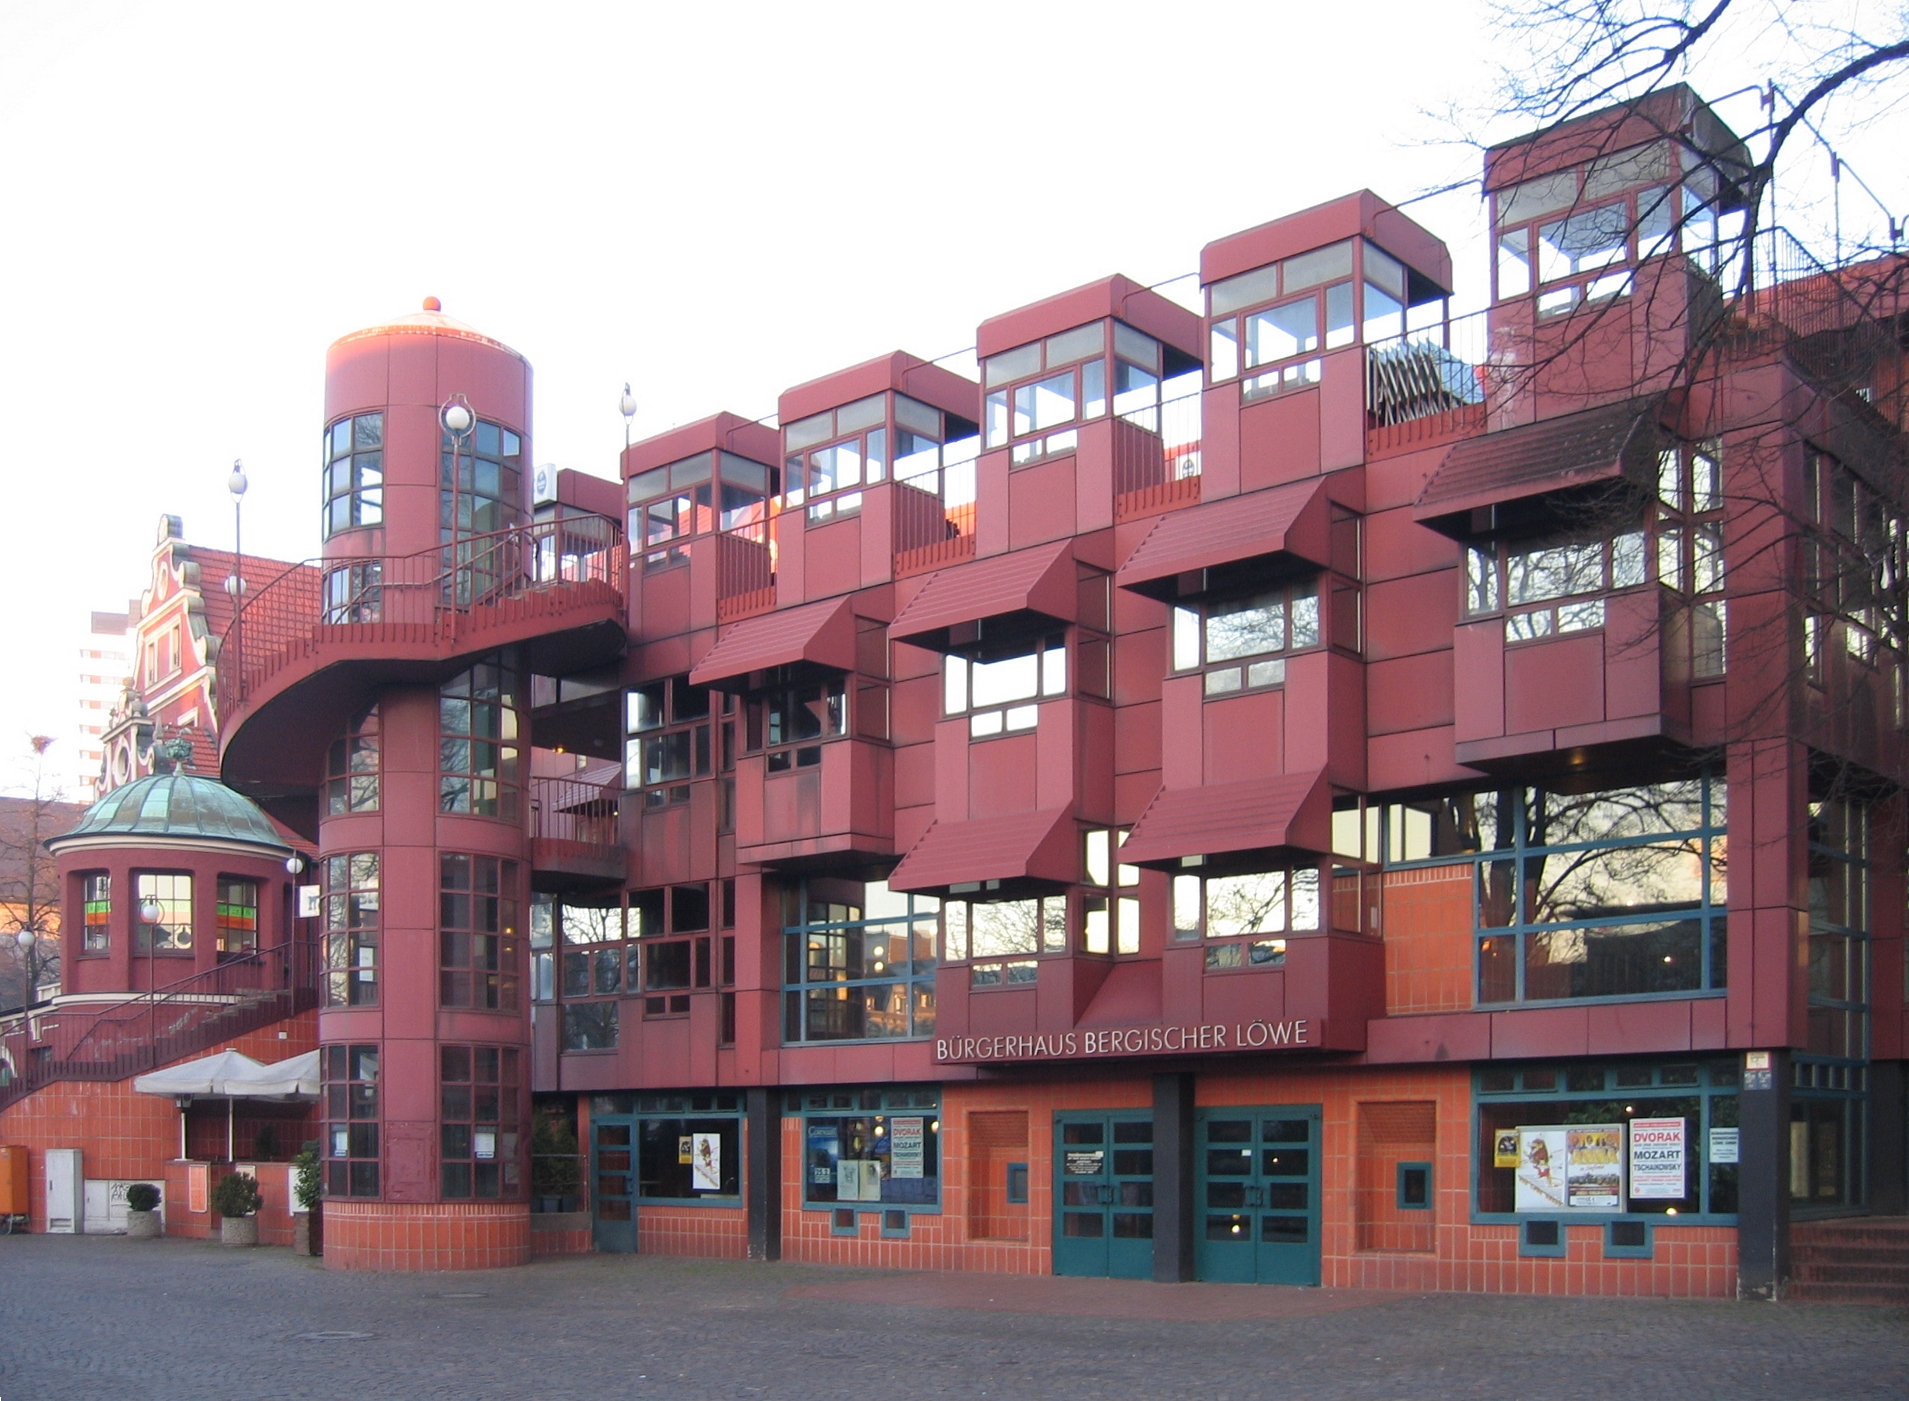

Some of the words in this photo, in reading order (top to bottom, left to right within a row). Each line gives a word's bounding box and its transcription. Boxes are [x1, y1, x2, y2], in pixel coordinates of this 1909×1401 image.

[936, 1032, 1077, 1061] BÜRGERHAUS
[1084, 1025, 1226, 1055] BERGISCHER
[1236, 1019, 1308, 1048] LÖWE
[1633, 1132, 1681, 1142] DVORAK
[1634, 1150, 1681, 1160] MOZART
